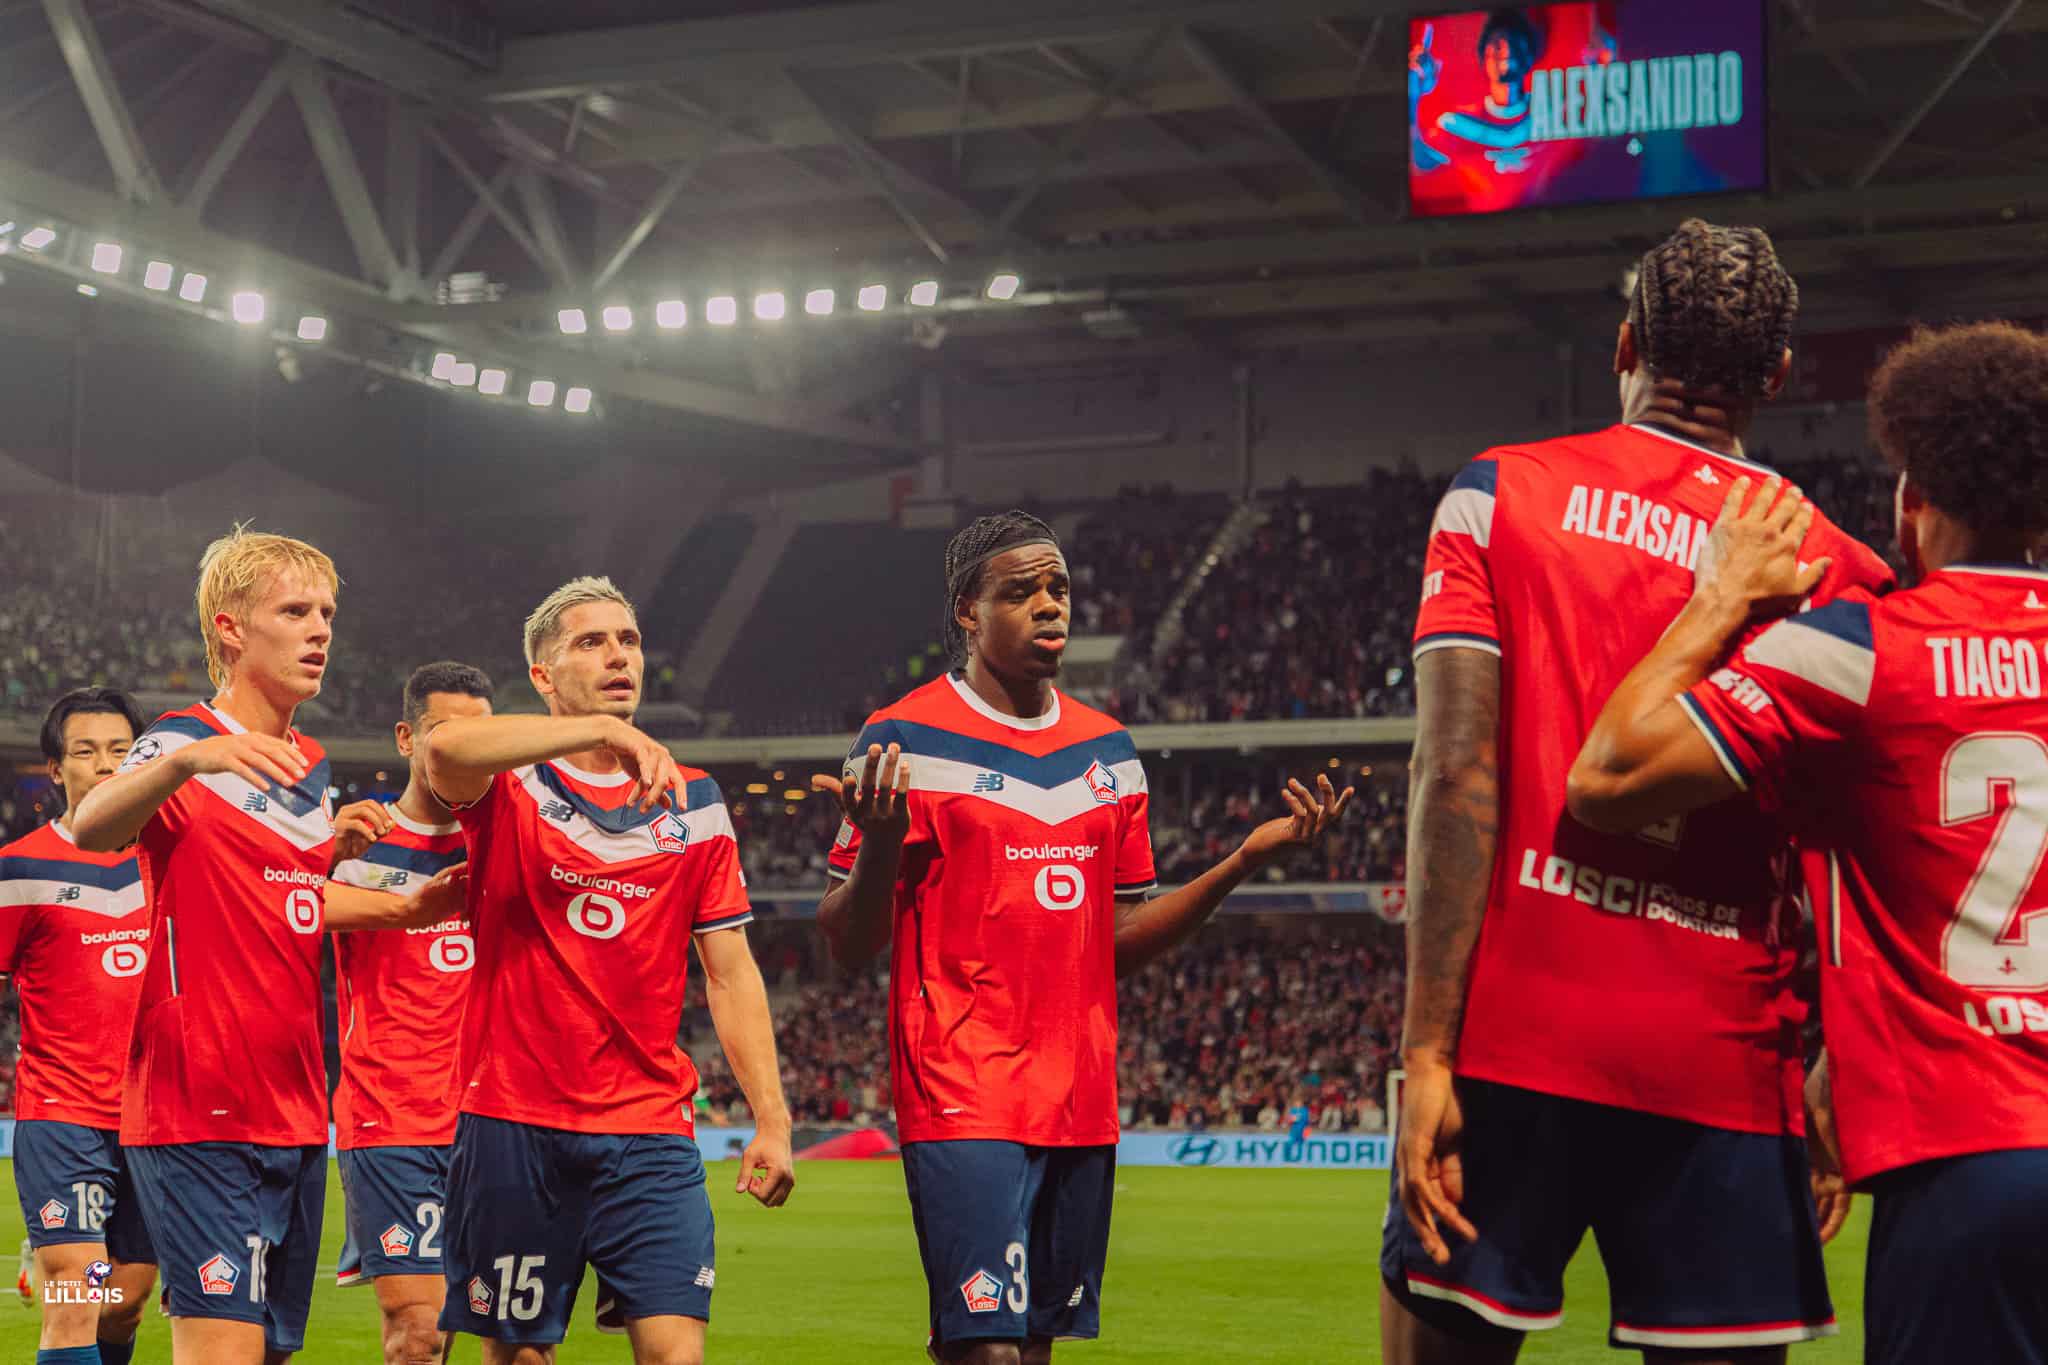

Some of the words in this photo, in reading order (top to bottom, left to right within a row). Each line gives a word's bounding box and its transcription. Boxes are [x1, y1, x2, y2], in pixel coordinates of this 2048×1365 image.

[1529, 51, 1743, 141] ALEXSANDRO
[1561, 484, 1708, 572] ALEXSAN
[1925, 636, 2041, 699] TIAGO
[659, 839, 683, 851] LOSC
[1005, 843, 1099, 862] boulanger
[1940, 731, 2048, 993] 2
[264, 866, 327, 888] boulange
[550, 864, 656, 899] boulanger
[1519, 848, 1636, 915] LOSC
[1236, 1140, 1385, 1163] HYUNDAI
[71, 1182, 105, 1232] 18
[416, 1202, 445, 1258] 2
[493, 1254, 546, 1320] 15
[1005, 1242, 1027, 1313] 3
